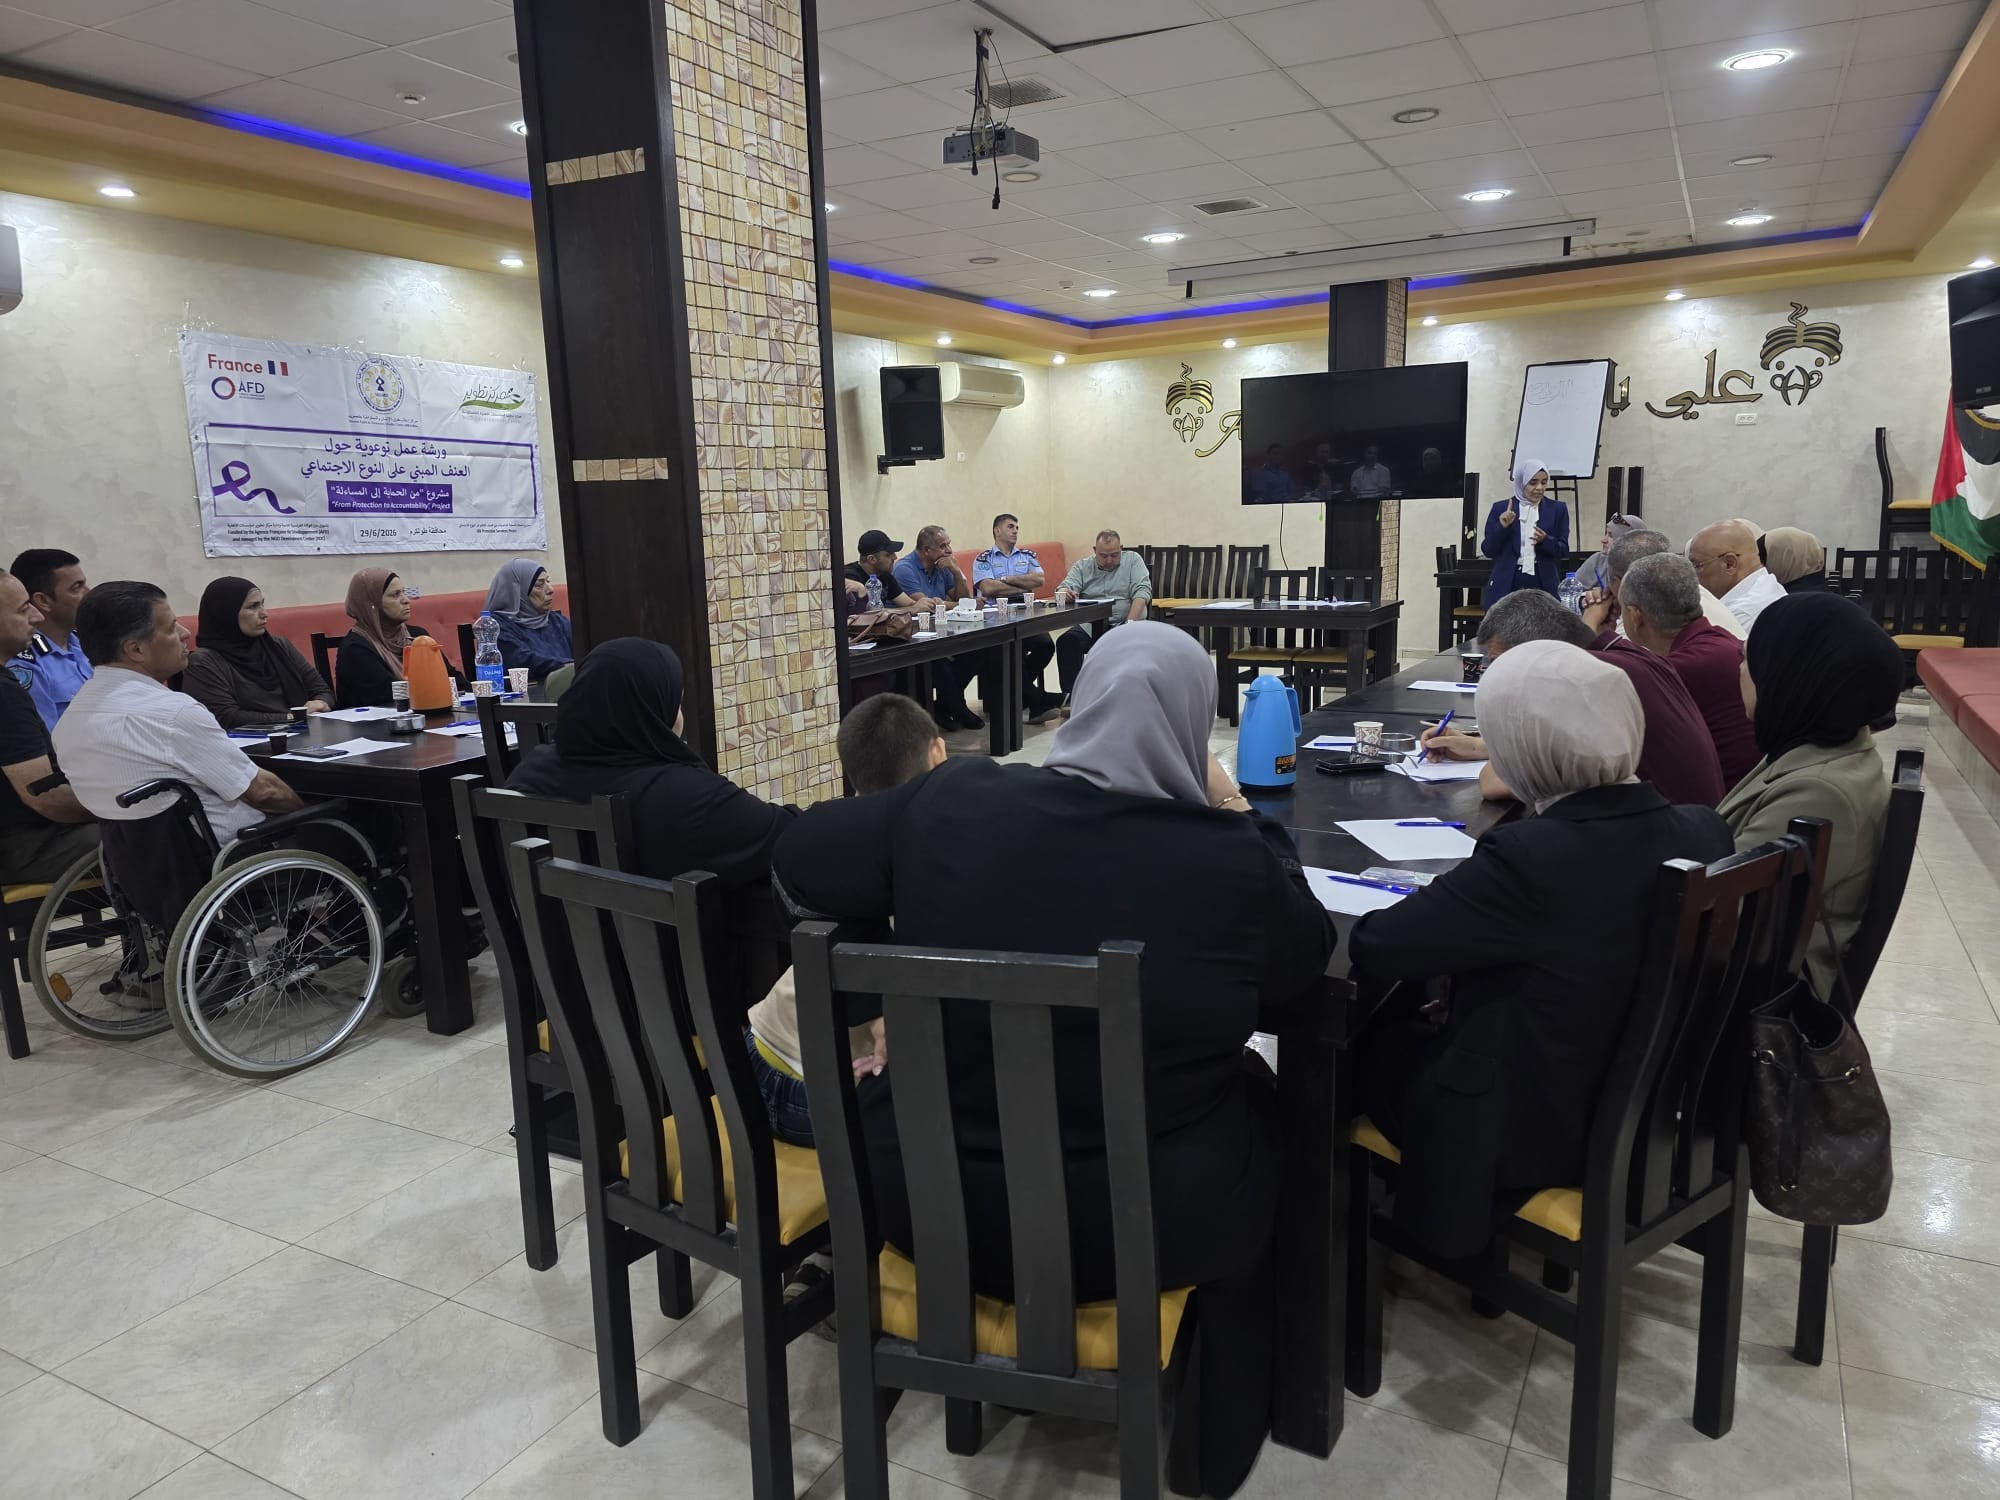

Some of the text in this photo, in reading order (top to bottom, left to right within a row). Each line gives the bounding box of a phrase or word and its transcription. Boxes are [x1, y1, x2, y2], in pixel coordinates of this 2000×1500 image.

[207, 353, 263, 374] France
[239, 381, 265, 394] AFD
[1645, 349, 1763, 420] علي
[325, 438, 447, 459] ورشة عمل توعوية حول
[301, 459, 471, 482] العنف المبني على النوع الاجتماعي
[370, 487, 381, 499] إلى
[352, 501, 383, 509] Protection
[431, 502, 451, 510] Project
